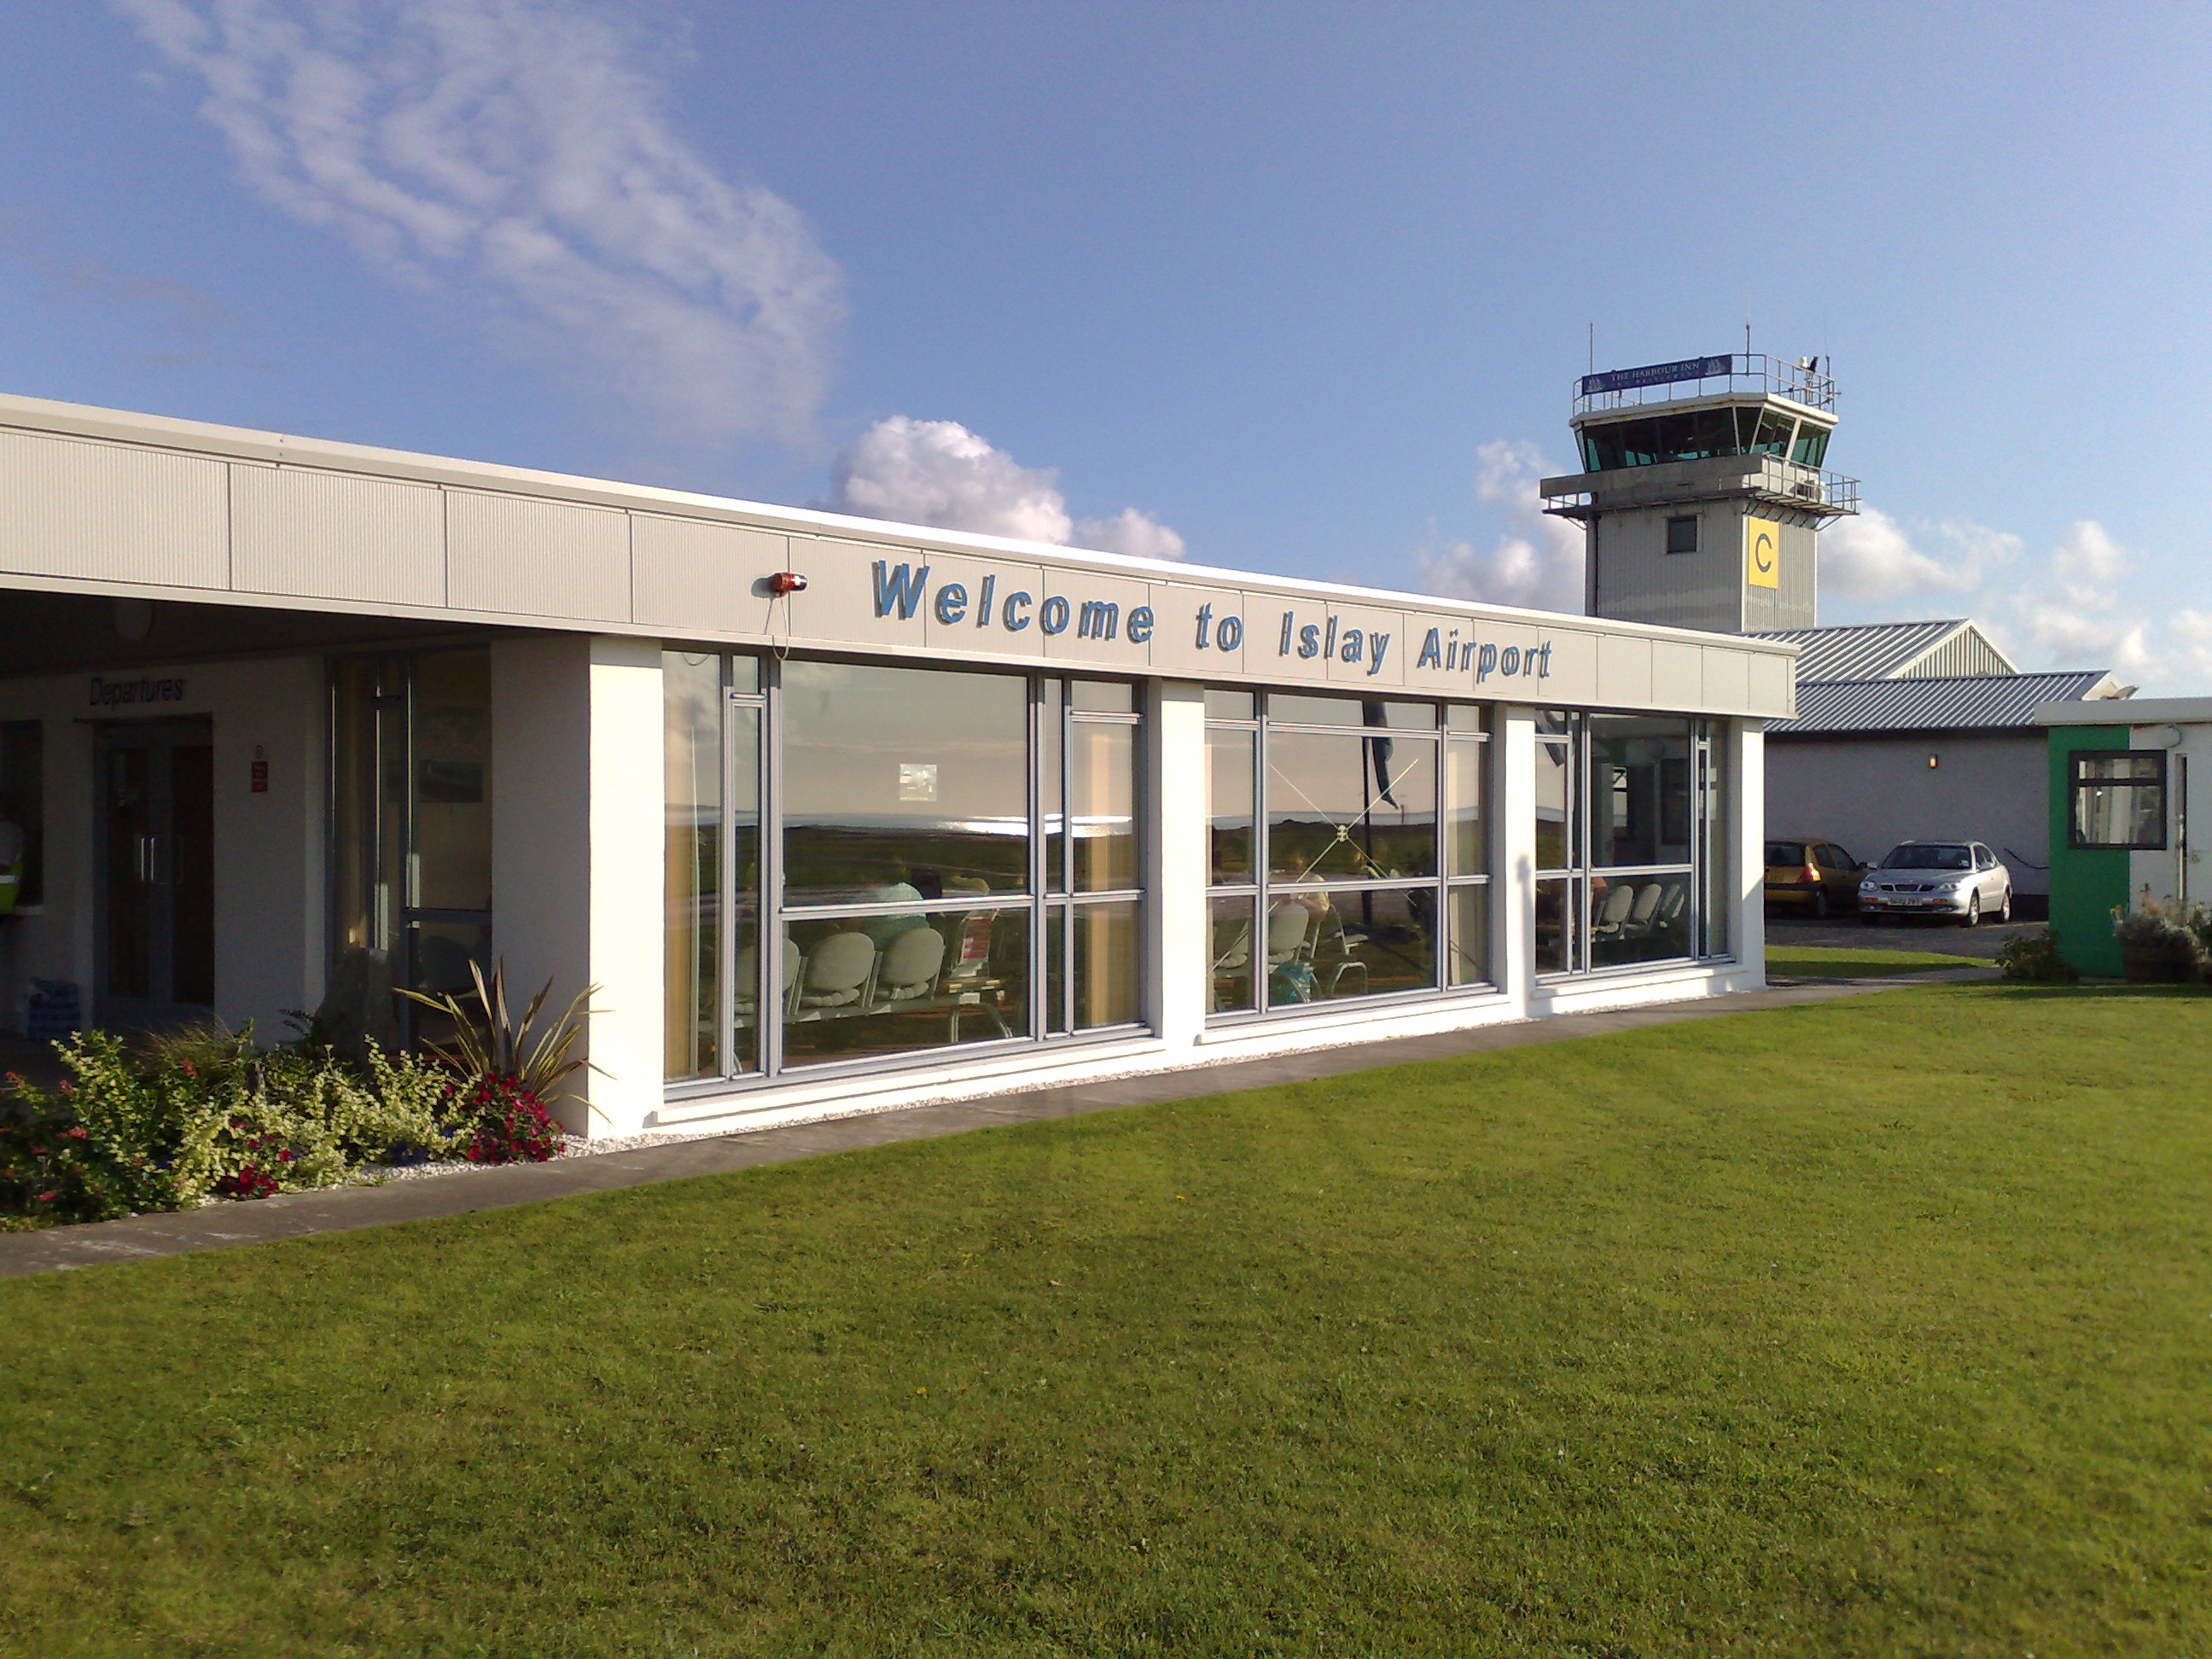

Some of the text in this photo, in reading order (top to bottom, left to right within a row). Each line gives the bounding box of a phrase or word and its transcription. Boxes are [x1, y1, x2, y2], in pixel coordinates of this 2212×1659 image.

[1610, 371, 1628, 381] THE
[1632, 365, 1678, 379] HARBOUR
[1681, 362, 1700, 373] INN
[1755, 533, 1773, 573] C
[871, 560, 1552, 684] Welcome to Islay Airport
[90, 678, 184, 709] Departures
